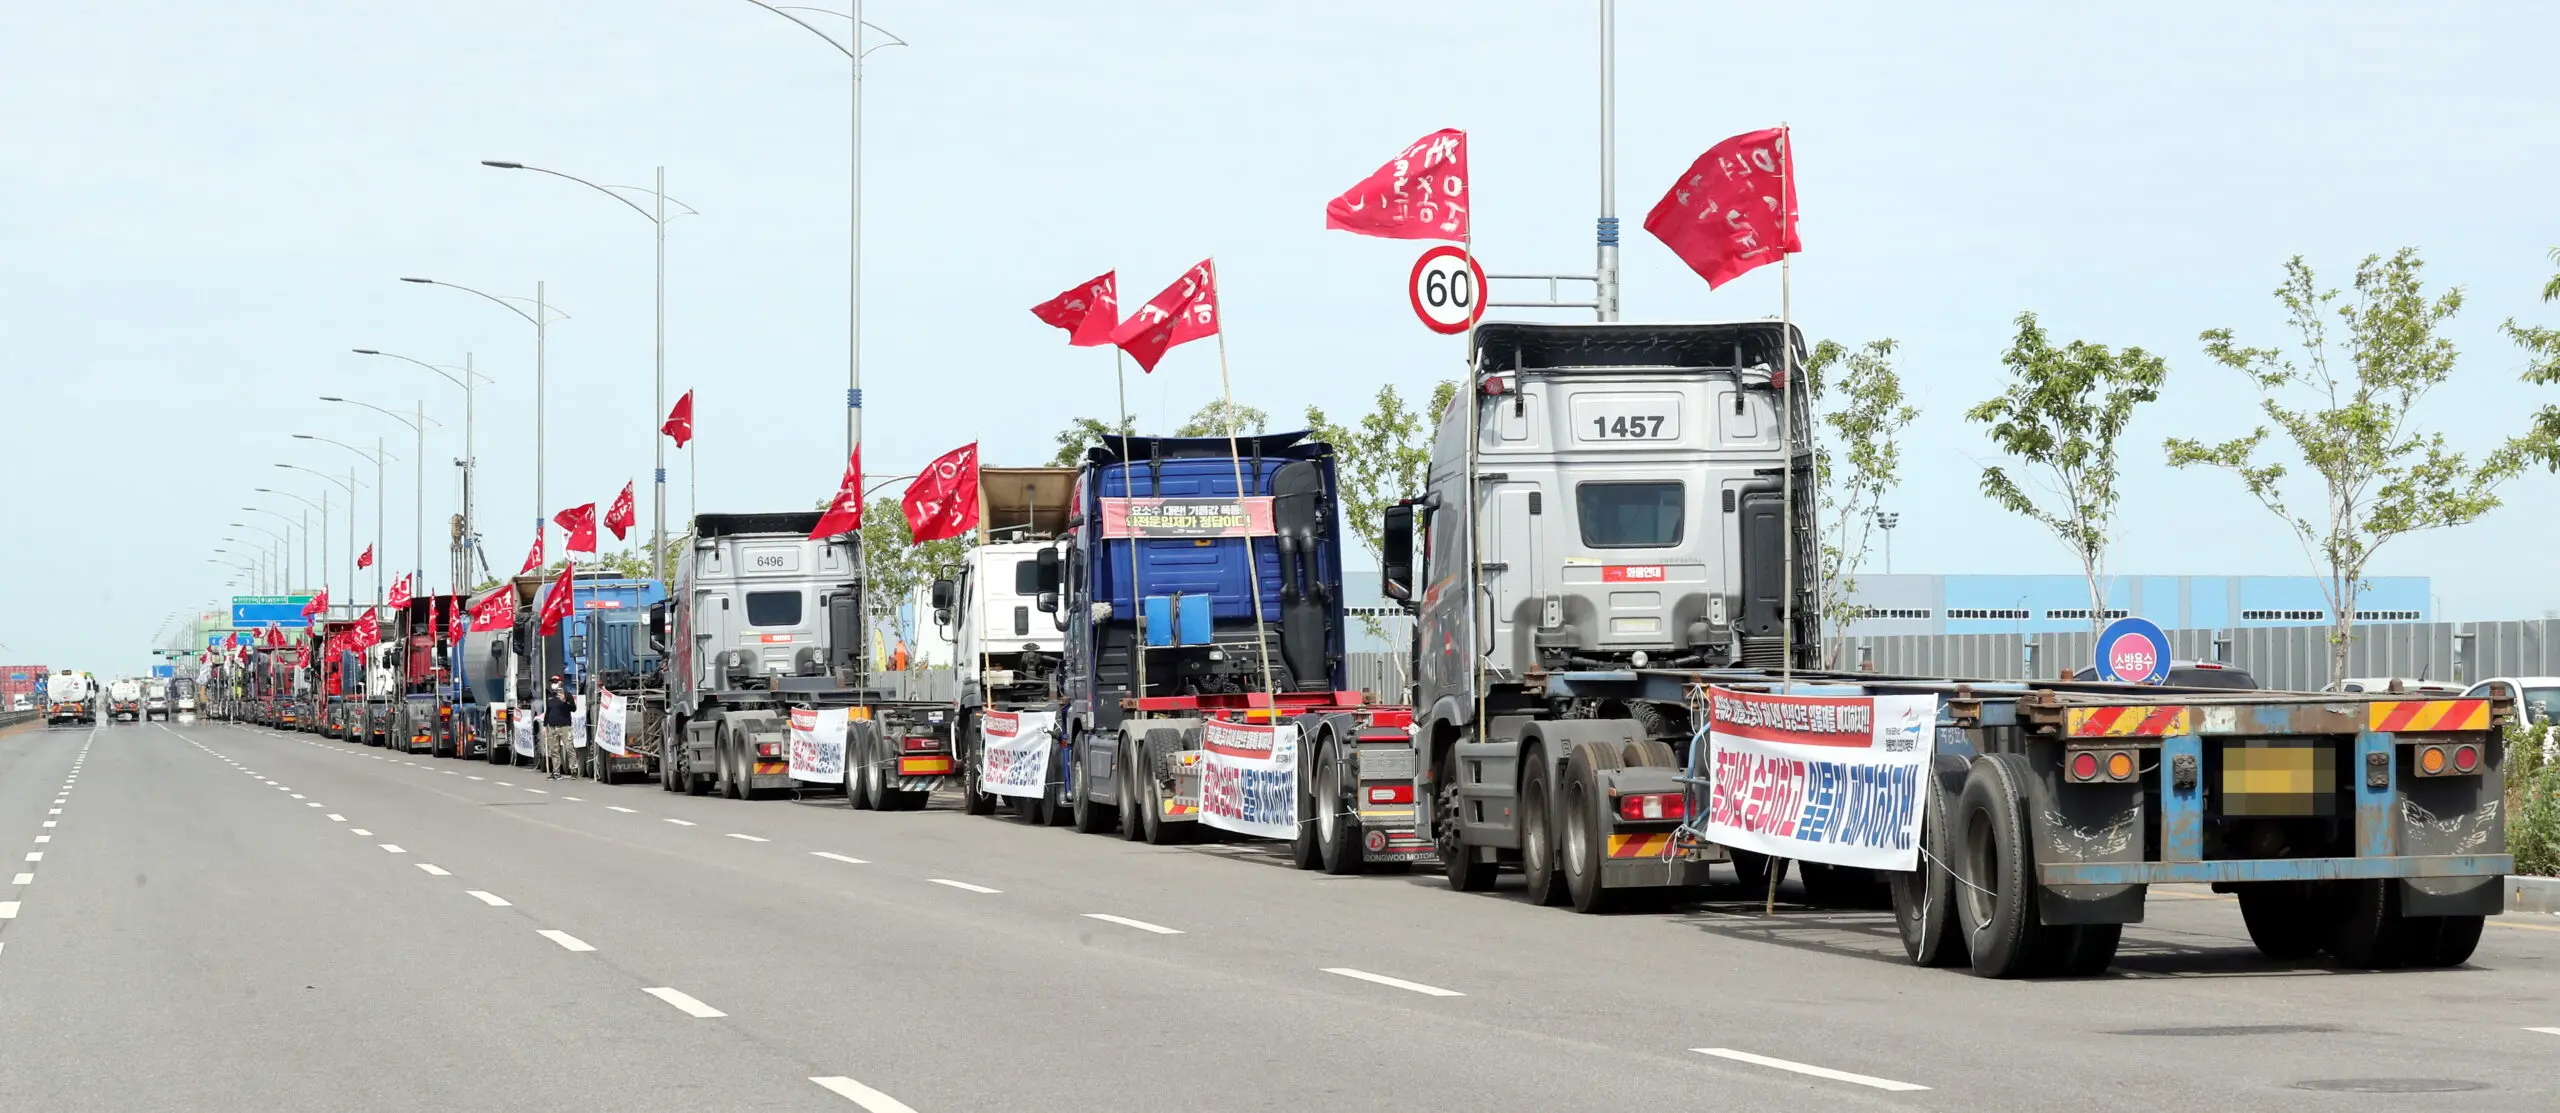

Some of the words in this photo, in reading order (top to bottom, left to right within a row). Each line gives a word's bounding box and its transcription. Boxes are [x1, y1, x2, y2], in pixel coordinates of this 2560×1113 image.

[1426, 269, 1470, 308] 60
[1593, 415, 1665, 438] 1457
[1131, 505, 1161, 516] 요소수
[1188, 504, 1219, 516] 기름값
[757, 556, 784, 567] 6496
[1625, 566, 1661, 578] 화물연대
[2114, 651, 2153, 671] 소방용수
[1809, 704, 1837, 734] 일몰제를
[1710, 747, 1753, 829] 총파업
[1744, 753, 1806, 838] 승리하고
[1795, 760, 1847, 844] 일몰제
[1840, 762, 1919, 851] 폐지하자!!
